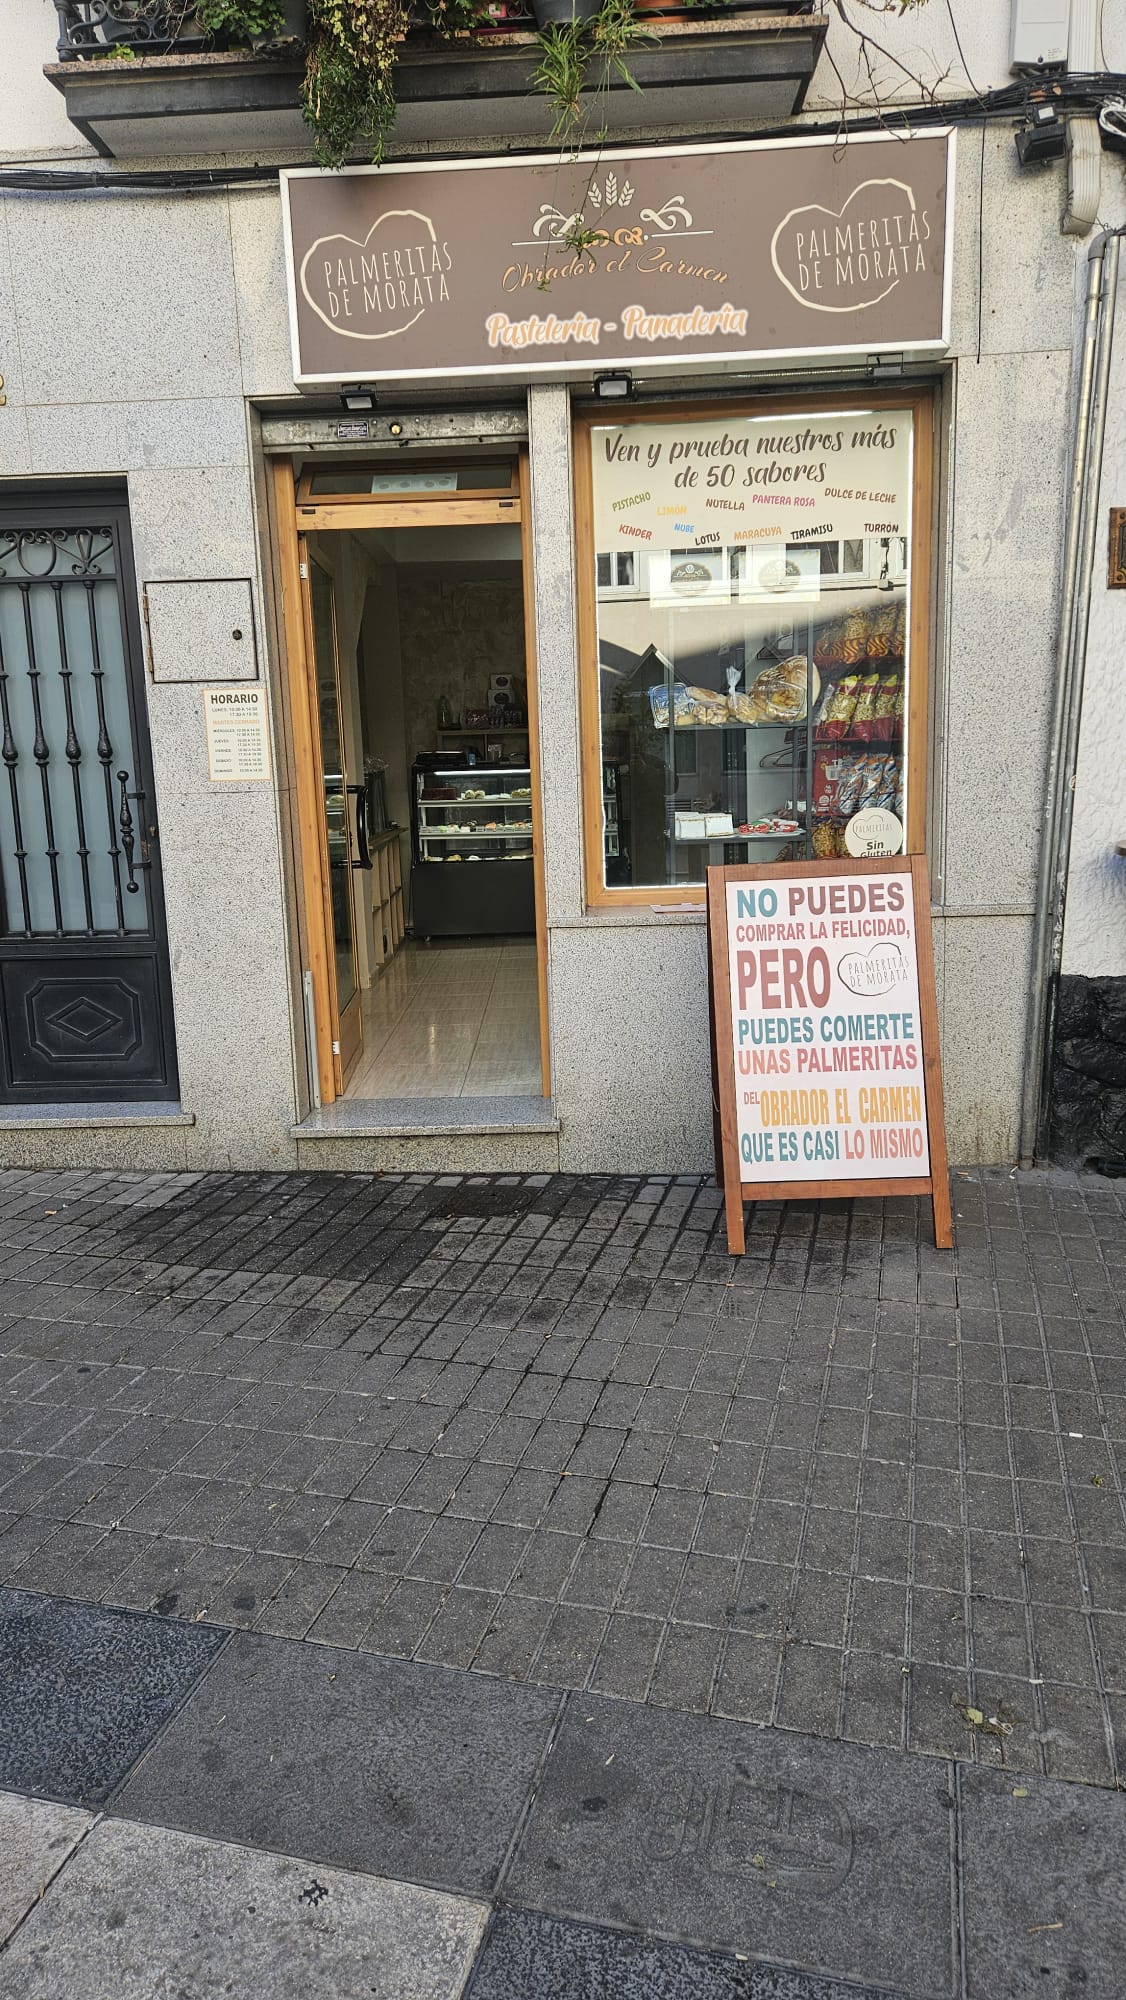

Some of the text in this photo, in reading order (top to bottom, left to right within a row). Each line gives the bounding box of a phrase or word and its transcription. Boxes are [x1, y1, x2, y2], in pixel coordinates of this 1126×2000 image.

[796, 209, 931, 260] PALMERITAS
[323, 240, 452, 289] PALMERITAS
[502, 256, 597, 293] Obrador
[636, 246, 729, 283] Carmen
[797, 242, 926, 291] DE MORATA
[328, 272, 451, 318] DE MORATA
[605, 424, 898, 468] Ven y prueba nuestros más
[674, 461, 827, 489] de 50 sabores
[612, 491, 652, 512] PISTACHO
[705, 498, 745, 511] NUTELLA
[752, 494, 816, 507] PANTERA ROSA
[824, 487, 897, 504] DULCE DE LECHE
[619, 523, 653, 541] KINDER
[674, 523, 695, 534] NUBE
[695, 531, 721, 546] LOTUS
[733, 526, 783, 541] MARACUYA
[790, 523, 834, 541] TIRAMISU
[210, 693, 259, 704] HORARIO
[866, 840, 884, 850] Sin
[737, 881, 905, 918] NO PUEDES
[736, 917, 911, 943] COMPRAR LA FELICIDAD,
[736, 945, 831, 1011] PERO
[848, 955, 910, 975] PALMERITAS
[850, 968, 908, 988] DE MORATA
[738, 1012, 914, 1045] PUEDES COMERTE
[738, 1044, 917, 1075] UNAS PALMERITAS
[743, 1086, 921, 1127] DEL OBRADOR EL CARMEN
[741, 1127, 923, 1164] QUE ES CASI LO MISMO
